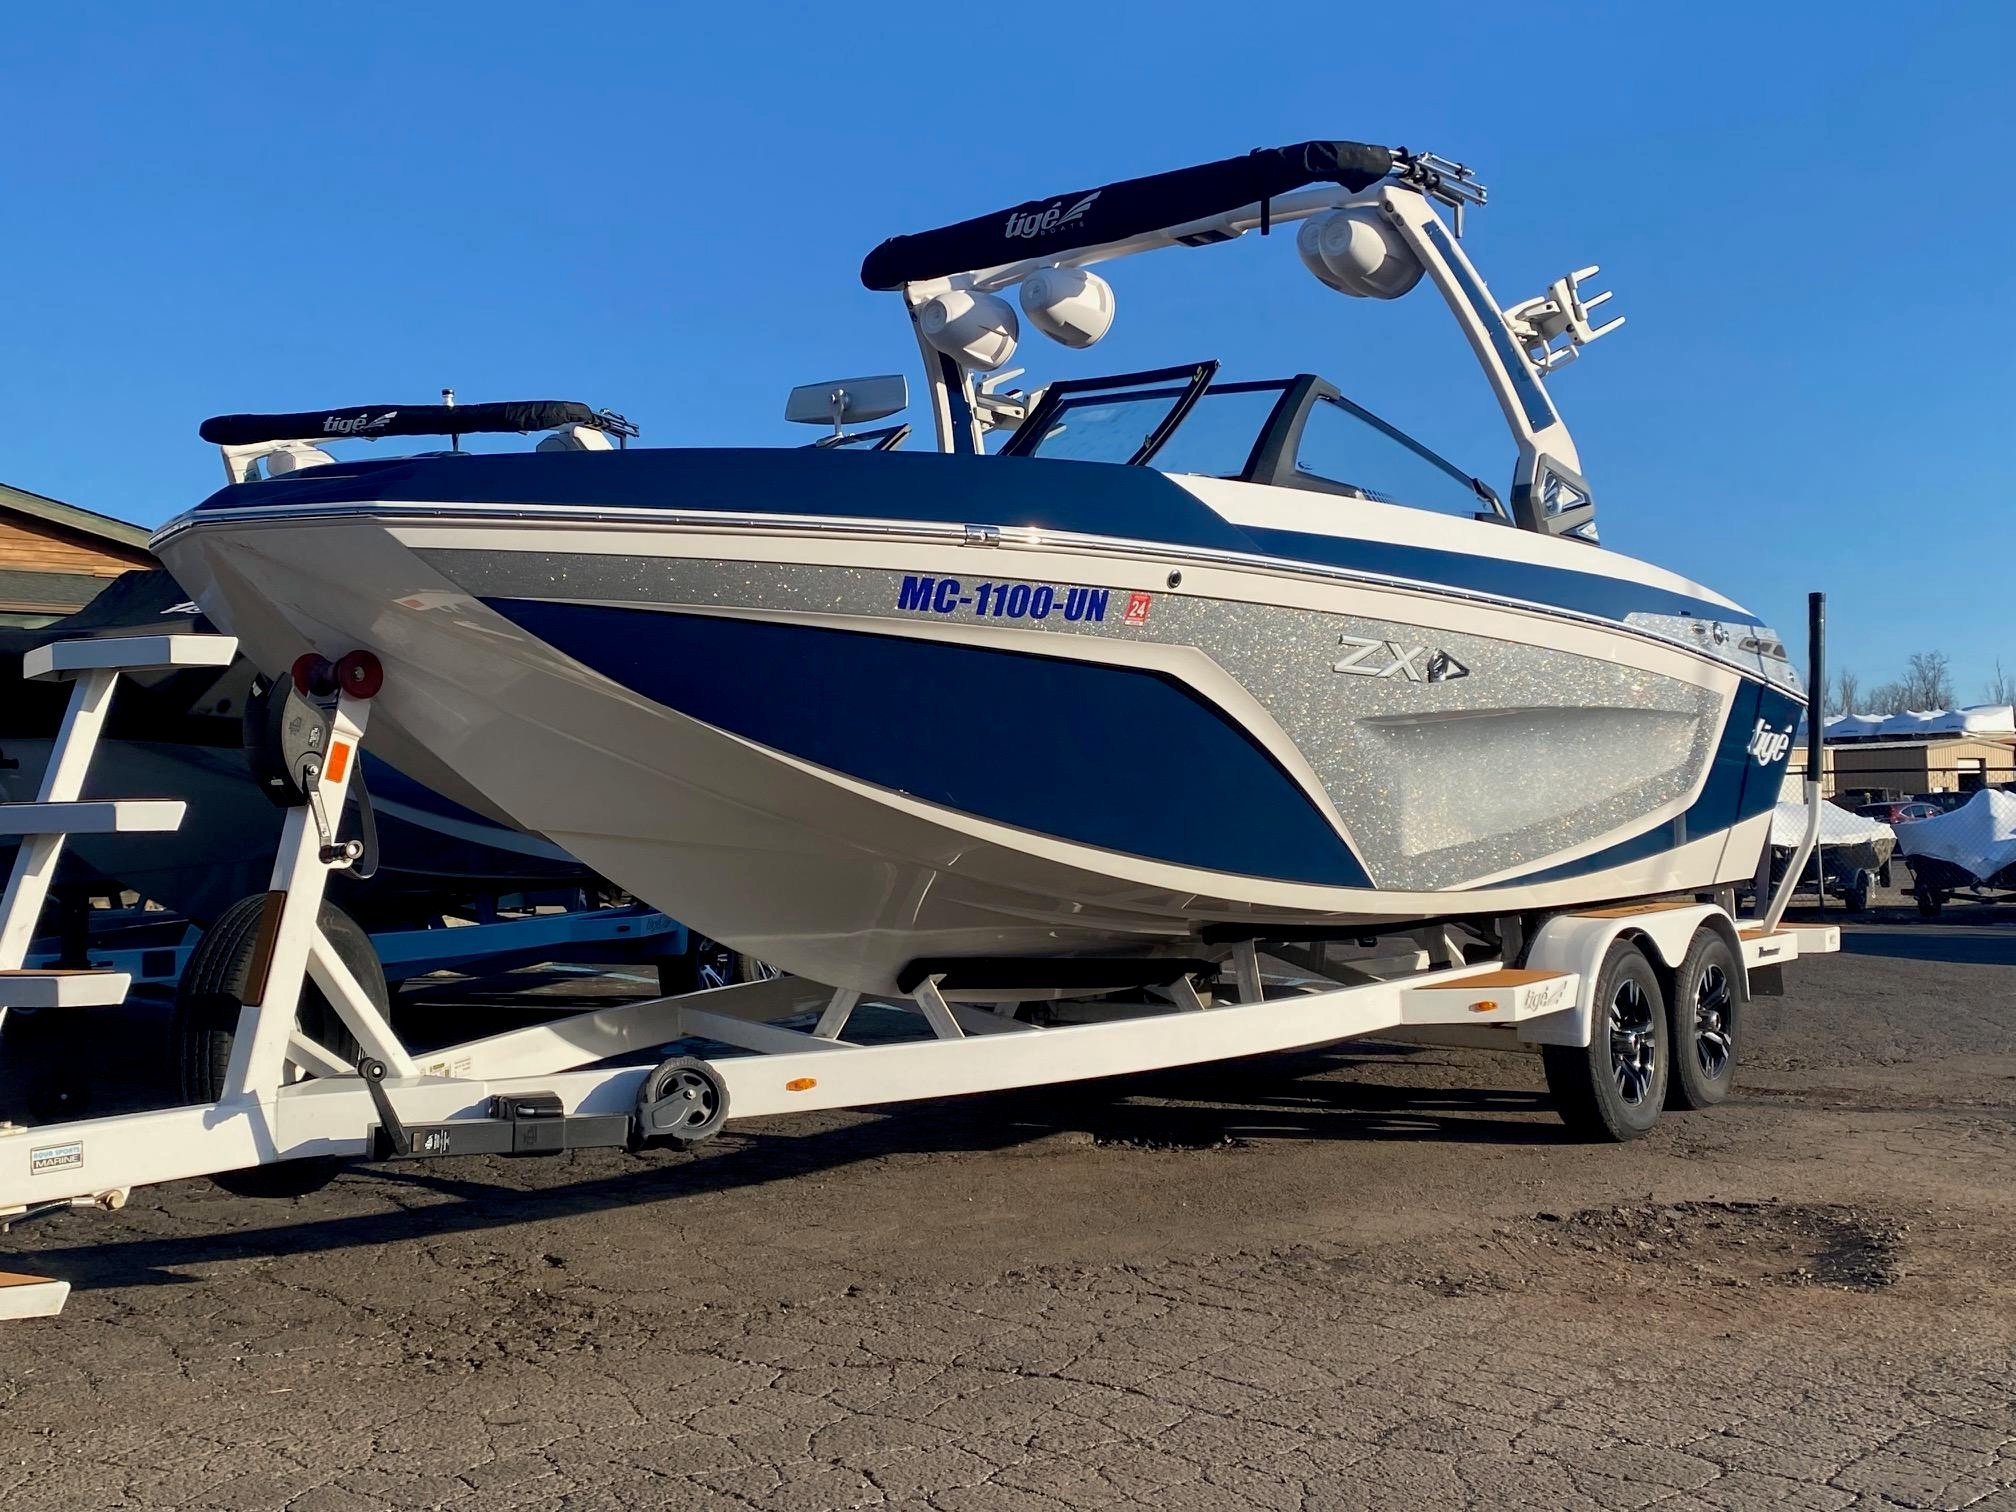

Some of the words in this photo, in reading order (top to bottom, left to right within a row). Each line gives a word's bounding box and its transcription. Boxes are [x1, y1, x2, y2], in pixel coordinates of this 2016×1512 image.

[1004, 201, 1062, 239] tigé
[1040, 220, 1085, 236] BOATS
[322, 413, 368, 434] tigé
[897, 575, 1109, 622] MC-1100-UN
[1129, 600, 1147, 618] 24
[1746, 717, 1793, 767] tigé
[35, 1154, 80, 1169] MARINE
